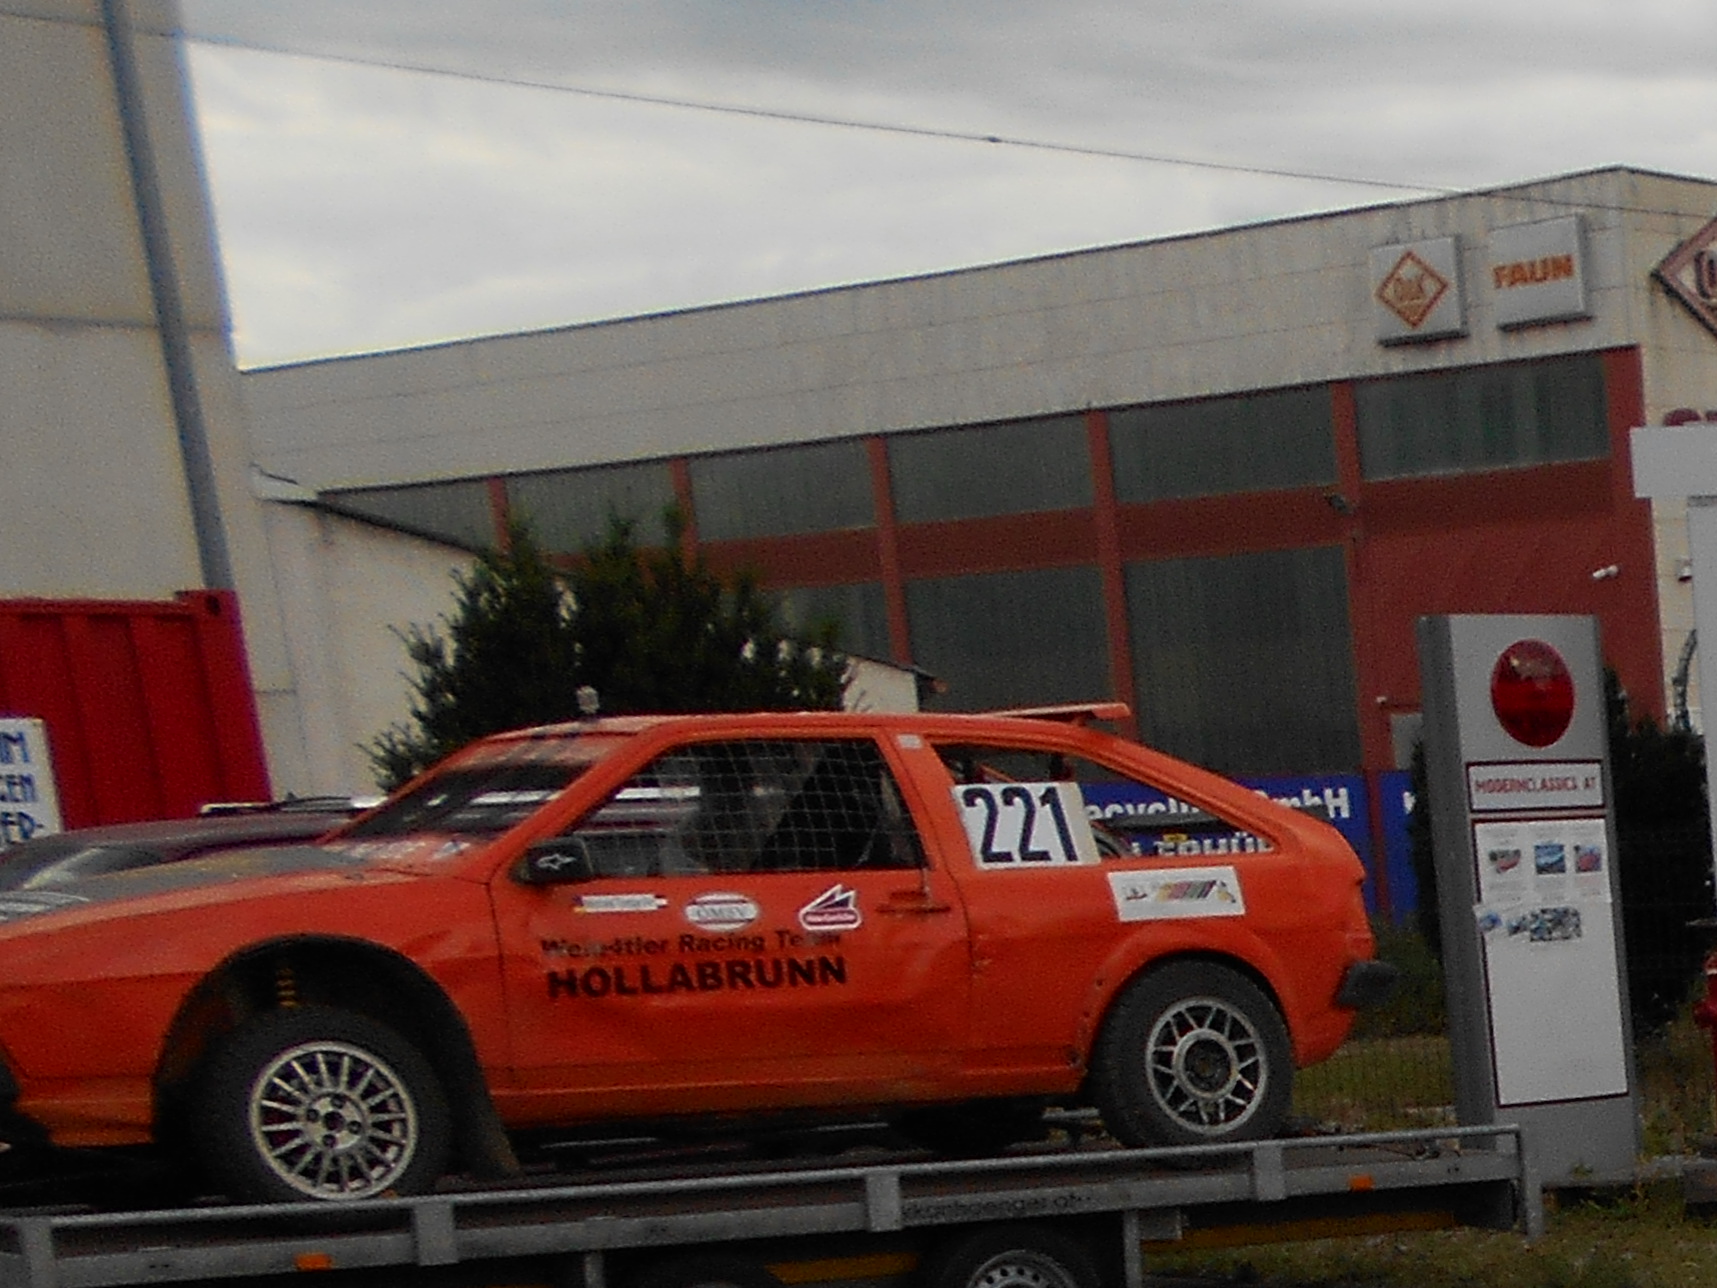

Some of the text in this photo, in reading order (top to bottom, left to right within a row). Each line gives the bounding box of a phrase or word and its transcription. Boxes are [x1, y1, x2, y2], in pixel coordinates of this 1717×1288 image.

[1493, 254, 1573, 289] FAUN
[964, 786, 1078, 863] 221
[679, 933, 765, 954] Racing
[775, 929, 842, 948] Tem
[549, 956, 847, 999] HOLLABRUNN
